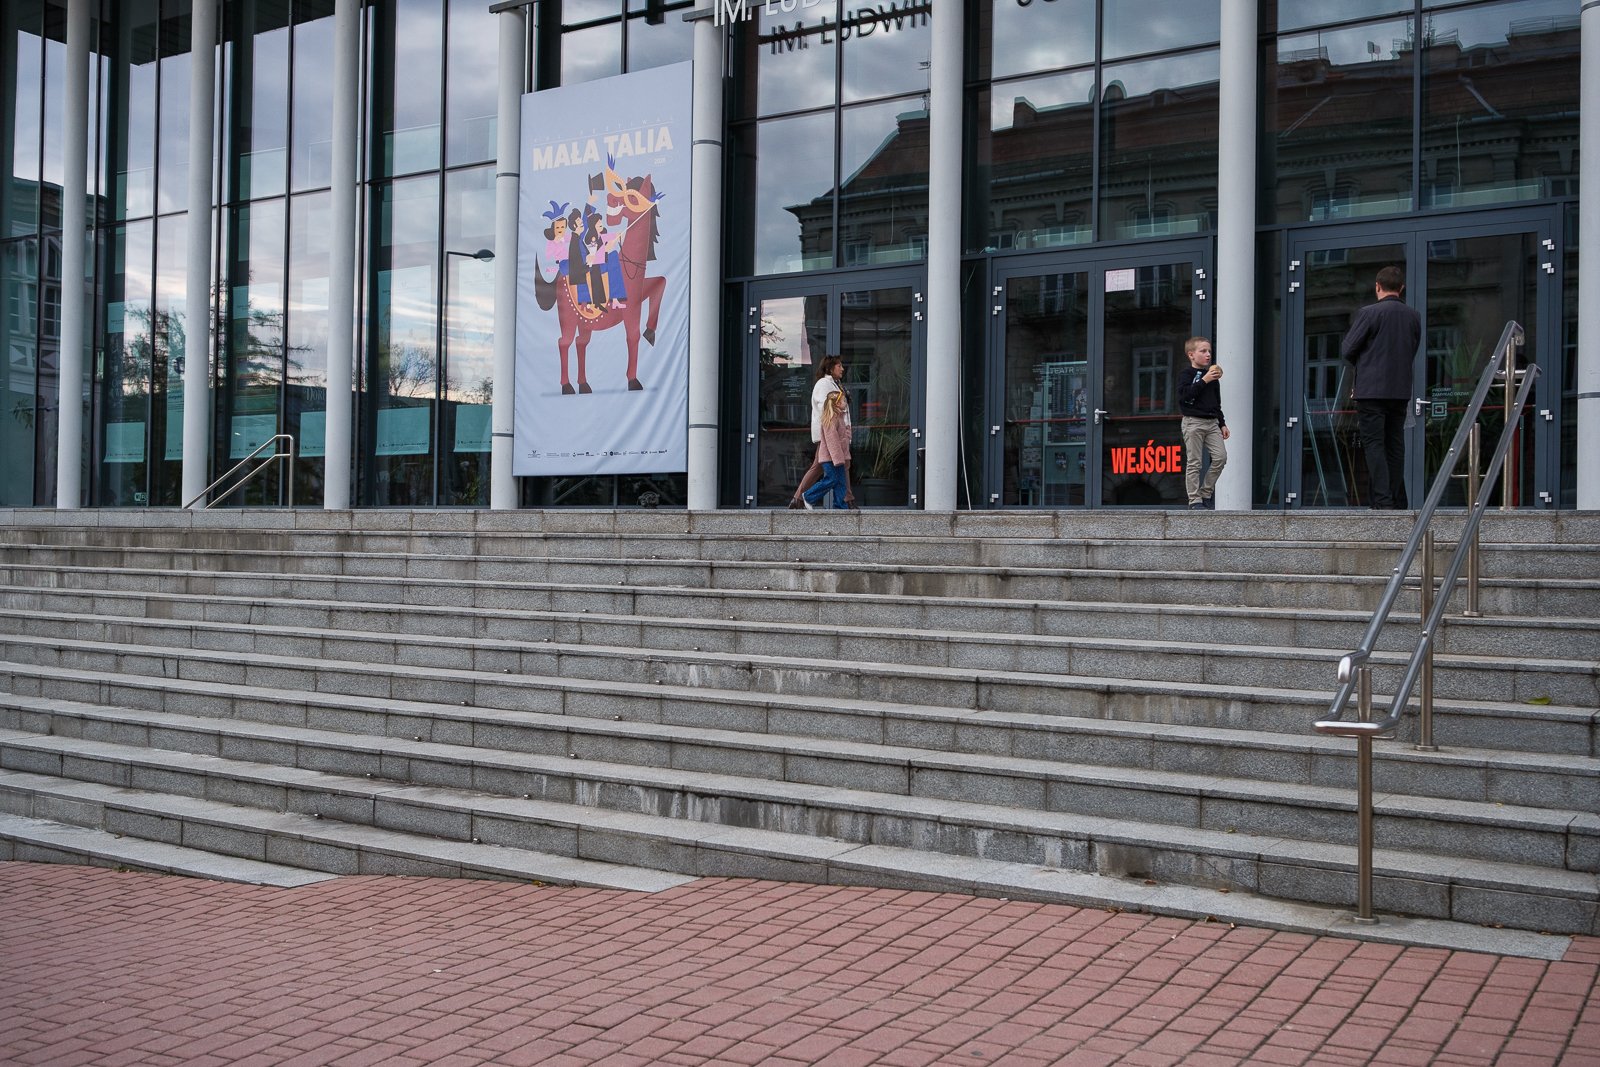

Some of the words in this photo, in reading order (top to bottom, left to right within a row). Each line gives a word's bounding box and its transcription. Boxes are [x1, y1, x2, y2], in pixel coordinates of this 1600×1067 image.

[533, 138, 600, 171] MAŁA
[604, 126, 674, 159] TALIA
[1111, 439, 1182, 475] WEJŚCIE
